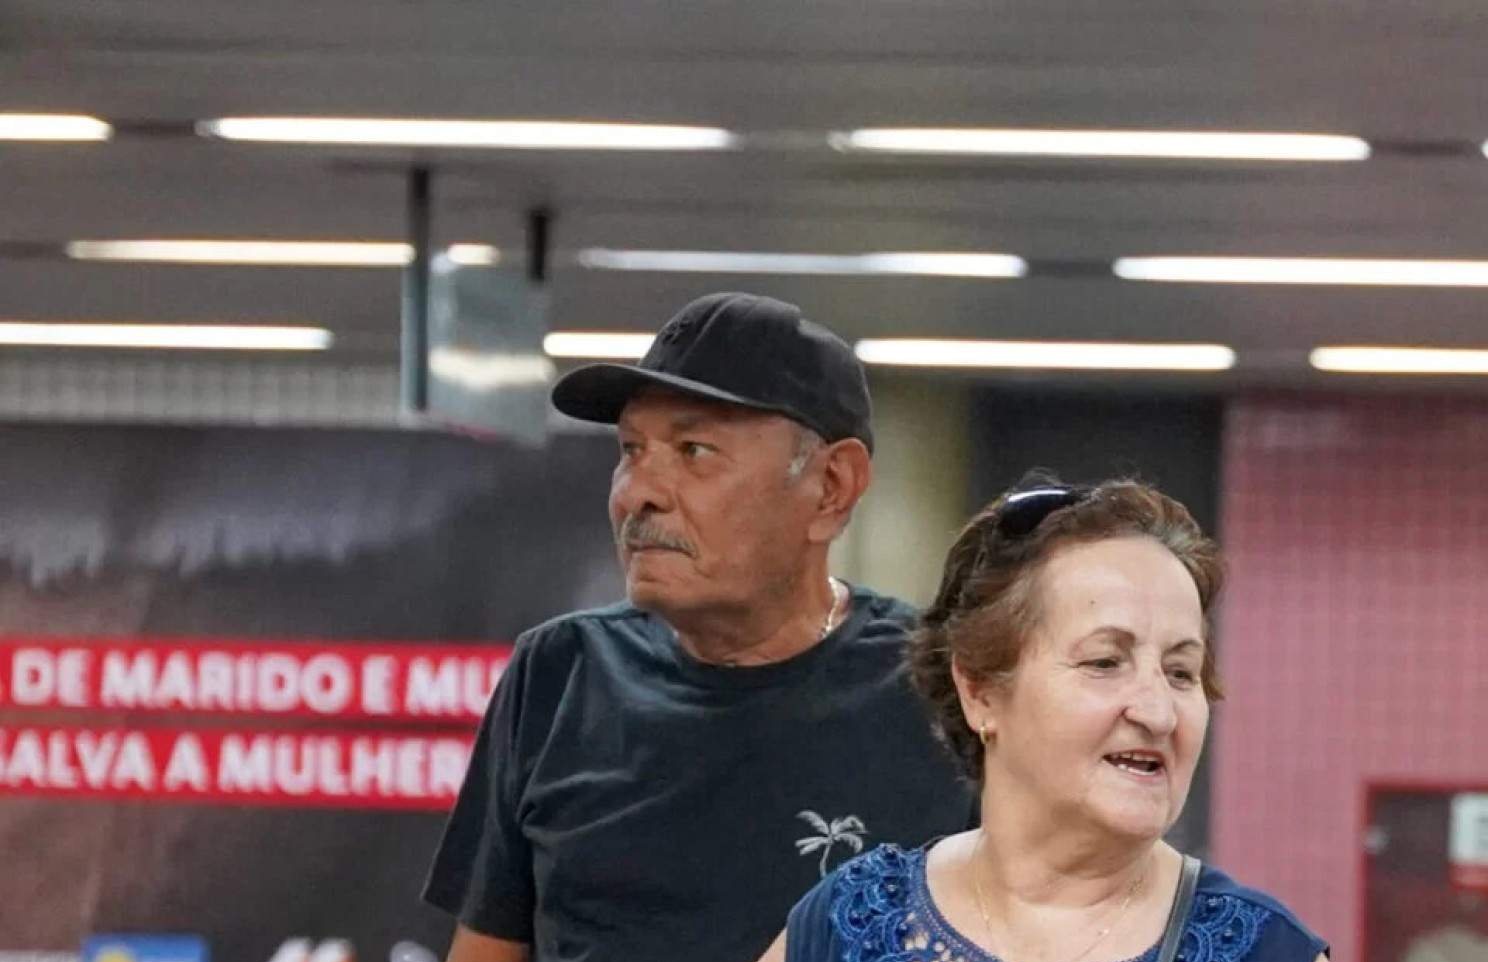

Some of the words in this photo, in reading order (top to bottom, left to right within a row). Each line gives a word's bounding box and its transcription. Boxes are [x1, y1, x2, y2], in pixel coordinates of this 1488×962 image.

[11, 648, 90, 707] DE
[102, 651, 352, 714] MARIDO
[362, 656, 393, 714] E
[0, 728, 154, 791] ALVA
[164, 733, 208, 792] A
[218, 735, 471, 797] MULHER
